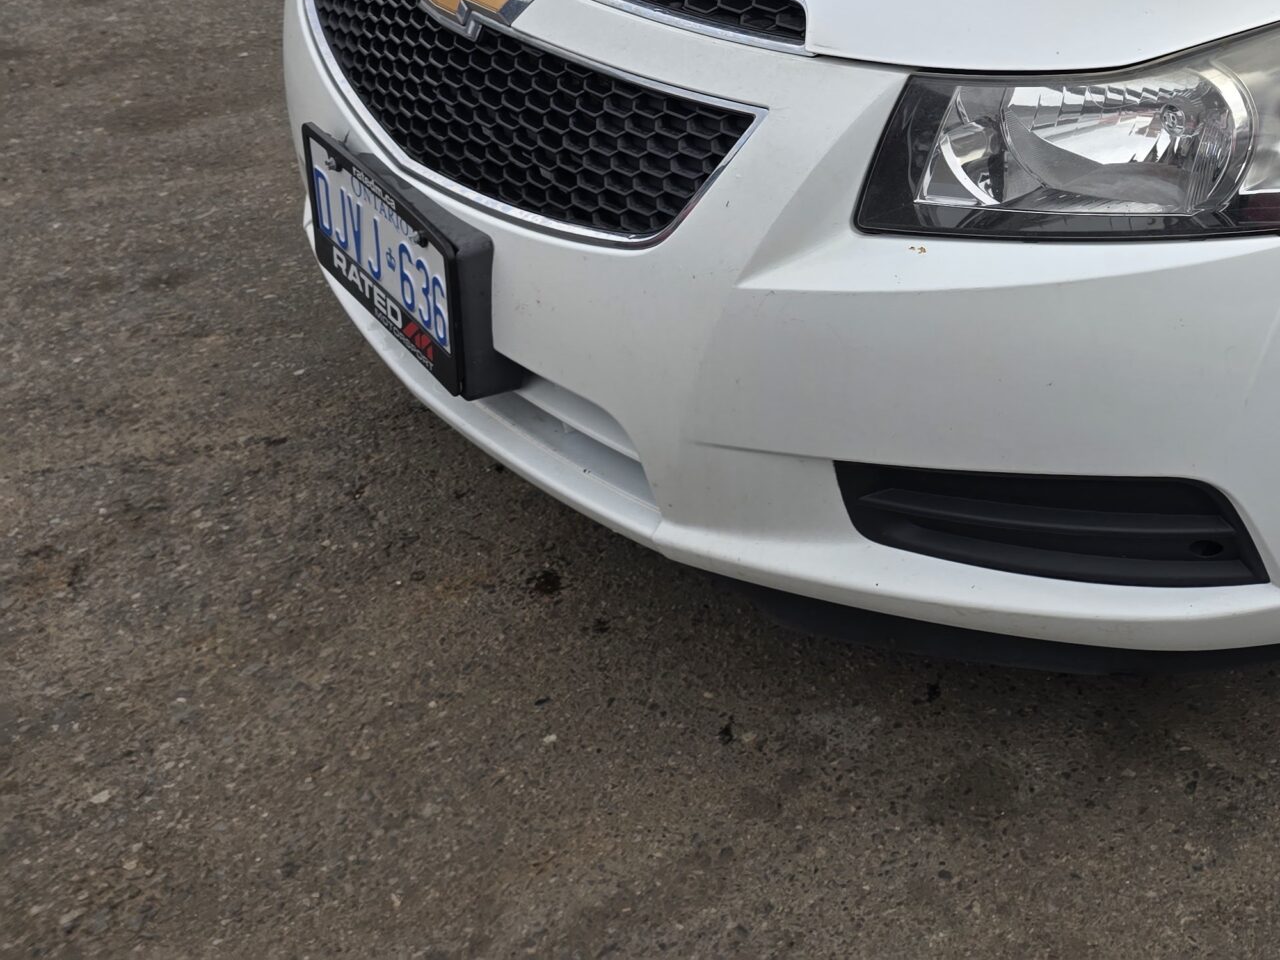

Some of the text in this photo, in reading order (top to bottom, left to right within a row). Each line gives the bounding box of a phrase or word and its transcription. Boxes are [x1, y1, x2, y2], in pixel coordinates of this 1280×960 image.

[351, 175, 409, 237] ONTARIO
[332, 246, 404, 330] RATED
[374, 307, 435, 372] MOTORSPORT
